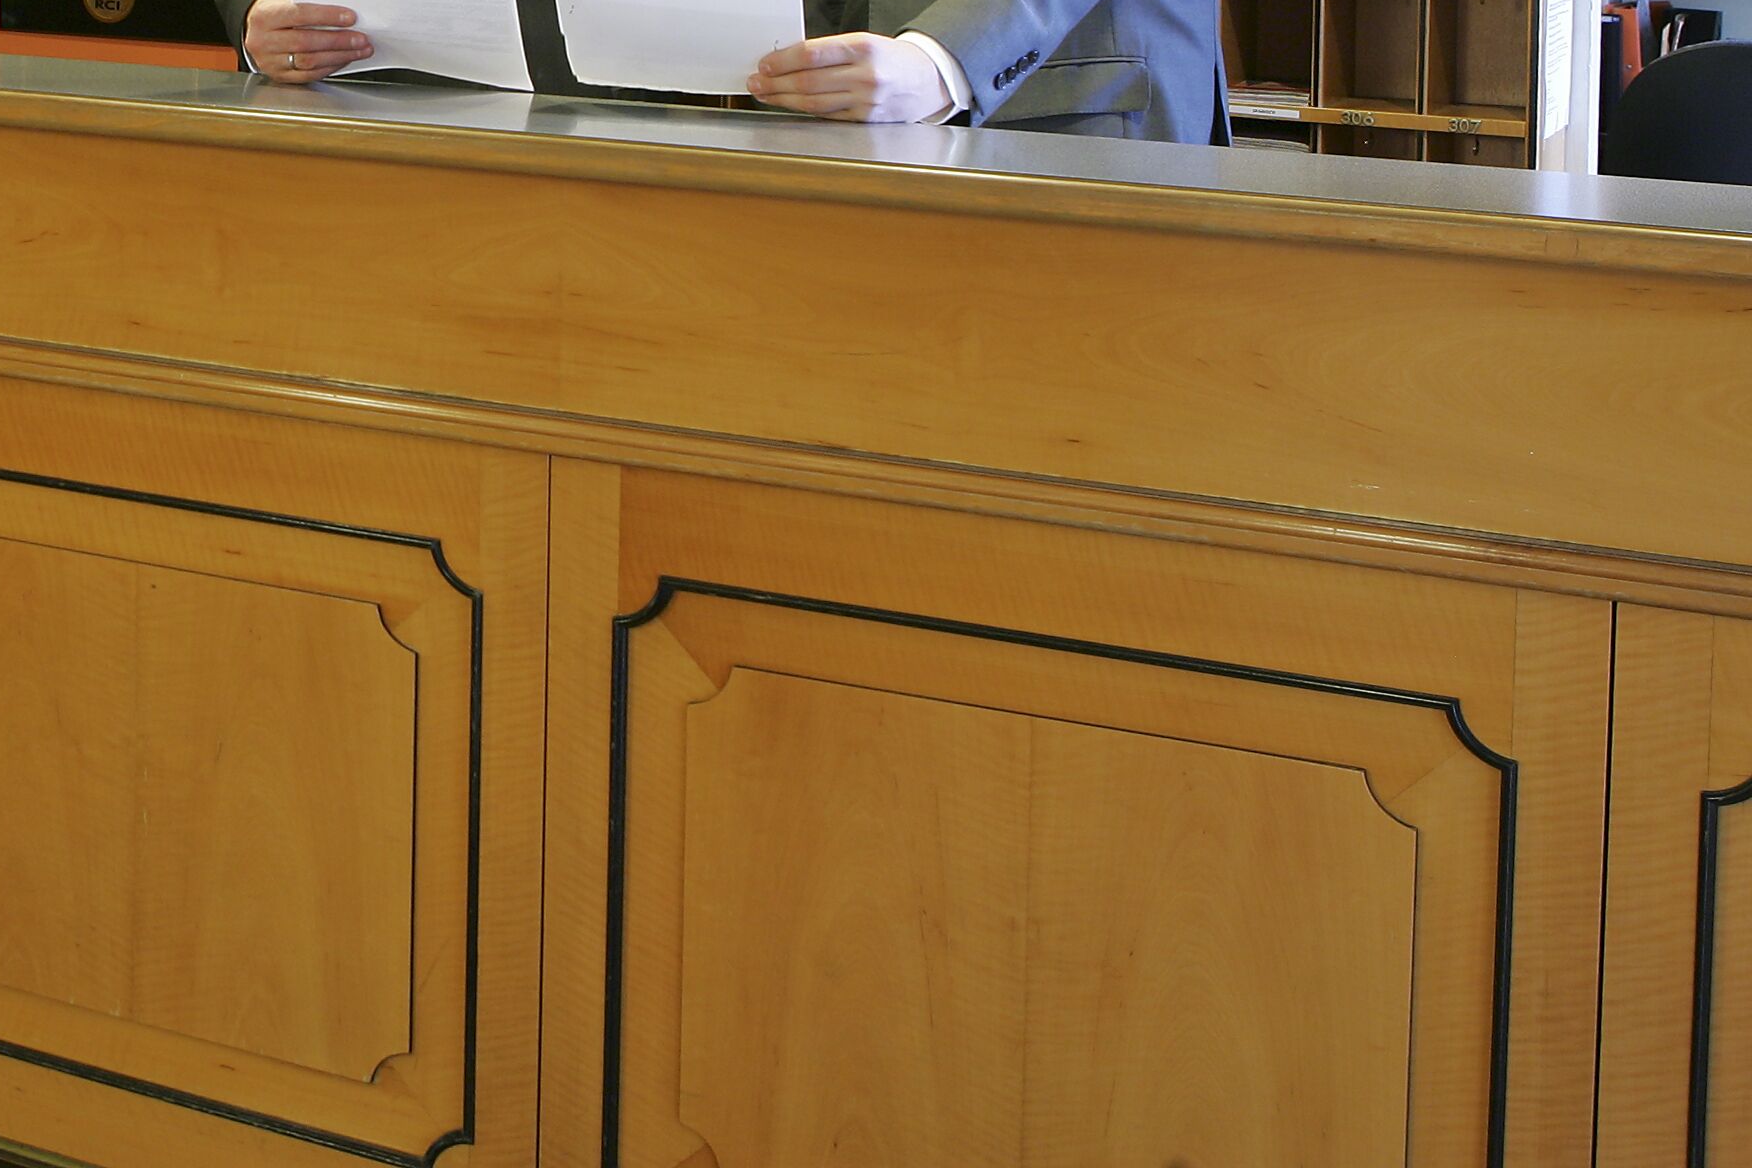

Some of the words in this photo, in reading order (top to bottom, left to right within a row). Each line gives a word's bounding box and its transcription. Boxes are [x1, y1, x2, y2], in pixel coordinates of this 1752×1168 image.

[94, 0, 120, 11] RCI
[1341, 110, 1375, 126] 306
[1448, 118, 1481, 134] 307
